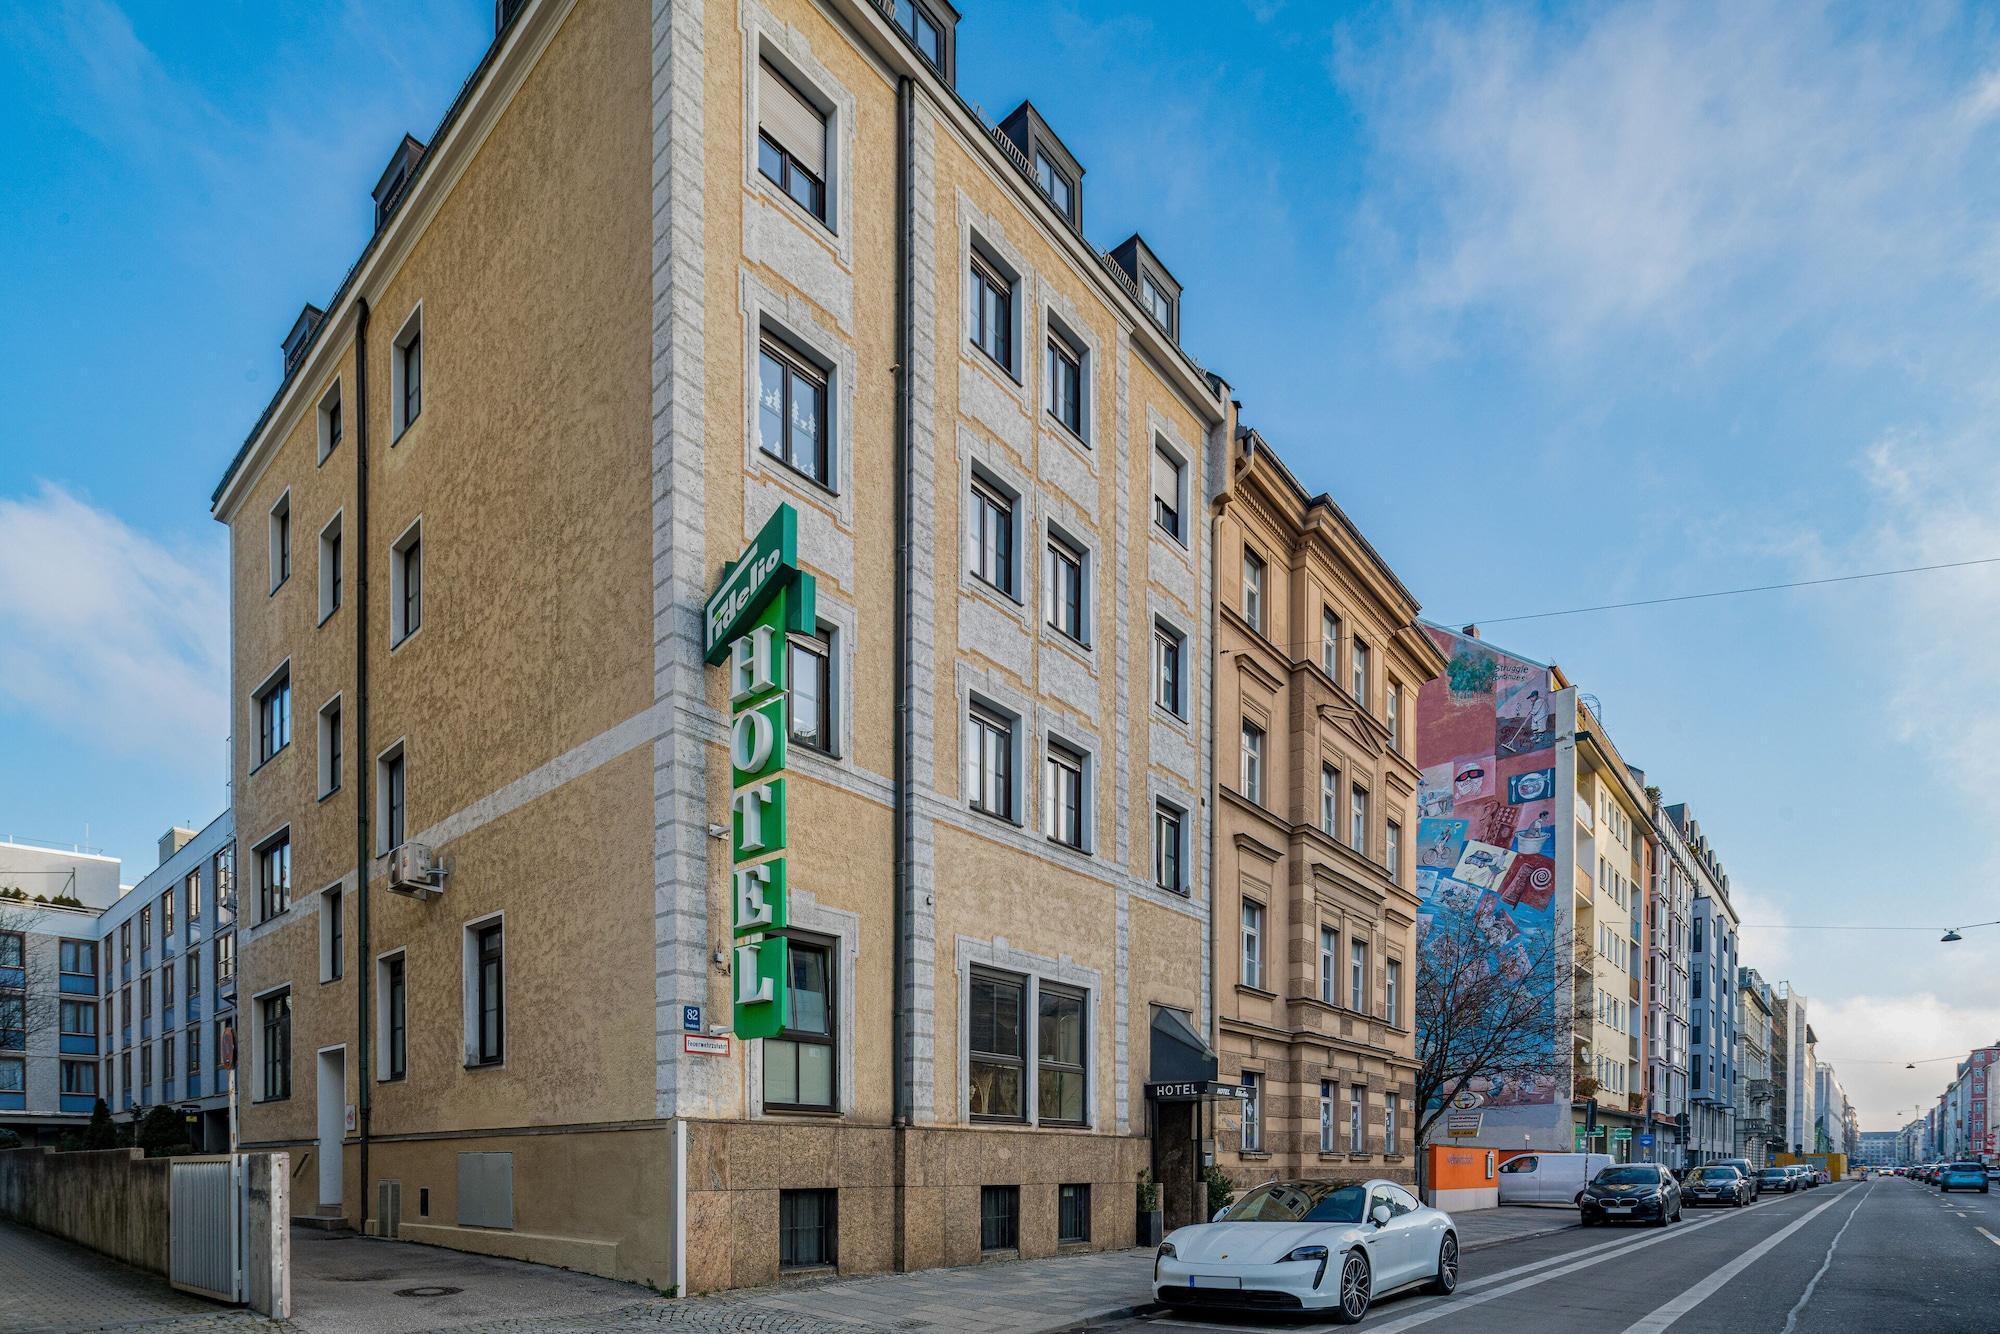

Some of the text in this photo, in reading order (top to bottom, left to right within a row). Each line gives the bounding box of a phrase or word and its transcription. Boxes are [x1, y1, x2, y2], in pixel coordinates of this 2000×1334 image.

[706, 543, 781, 651] Fidelio
[728, 624, 776, 1005] HOTEL
[687, 1008, 699, 1021] 82
[1156, 1083, 1198, 1096] HOTEL
